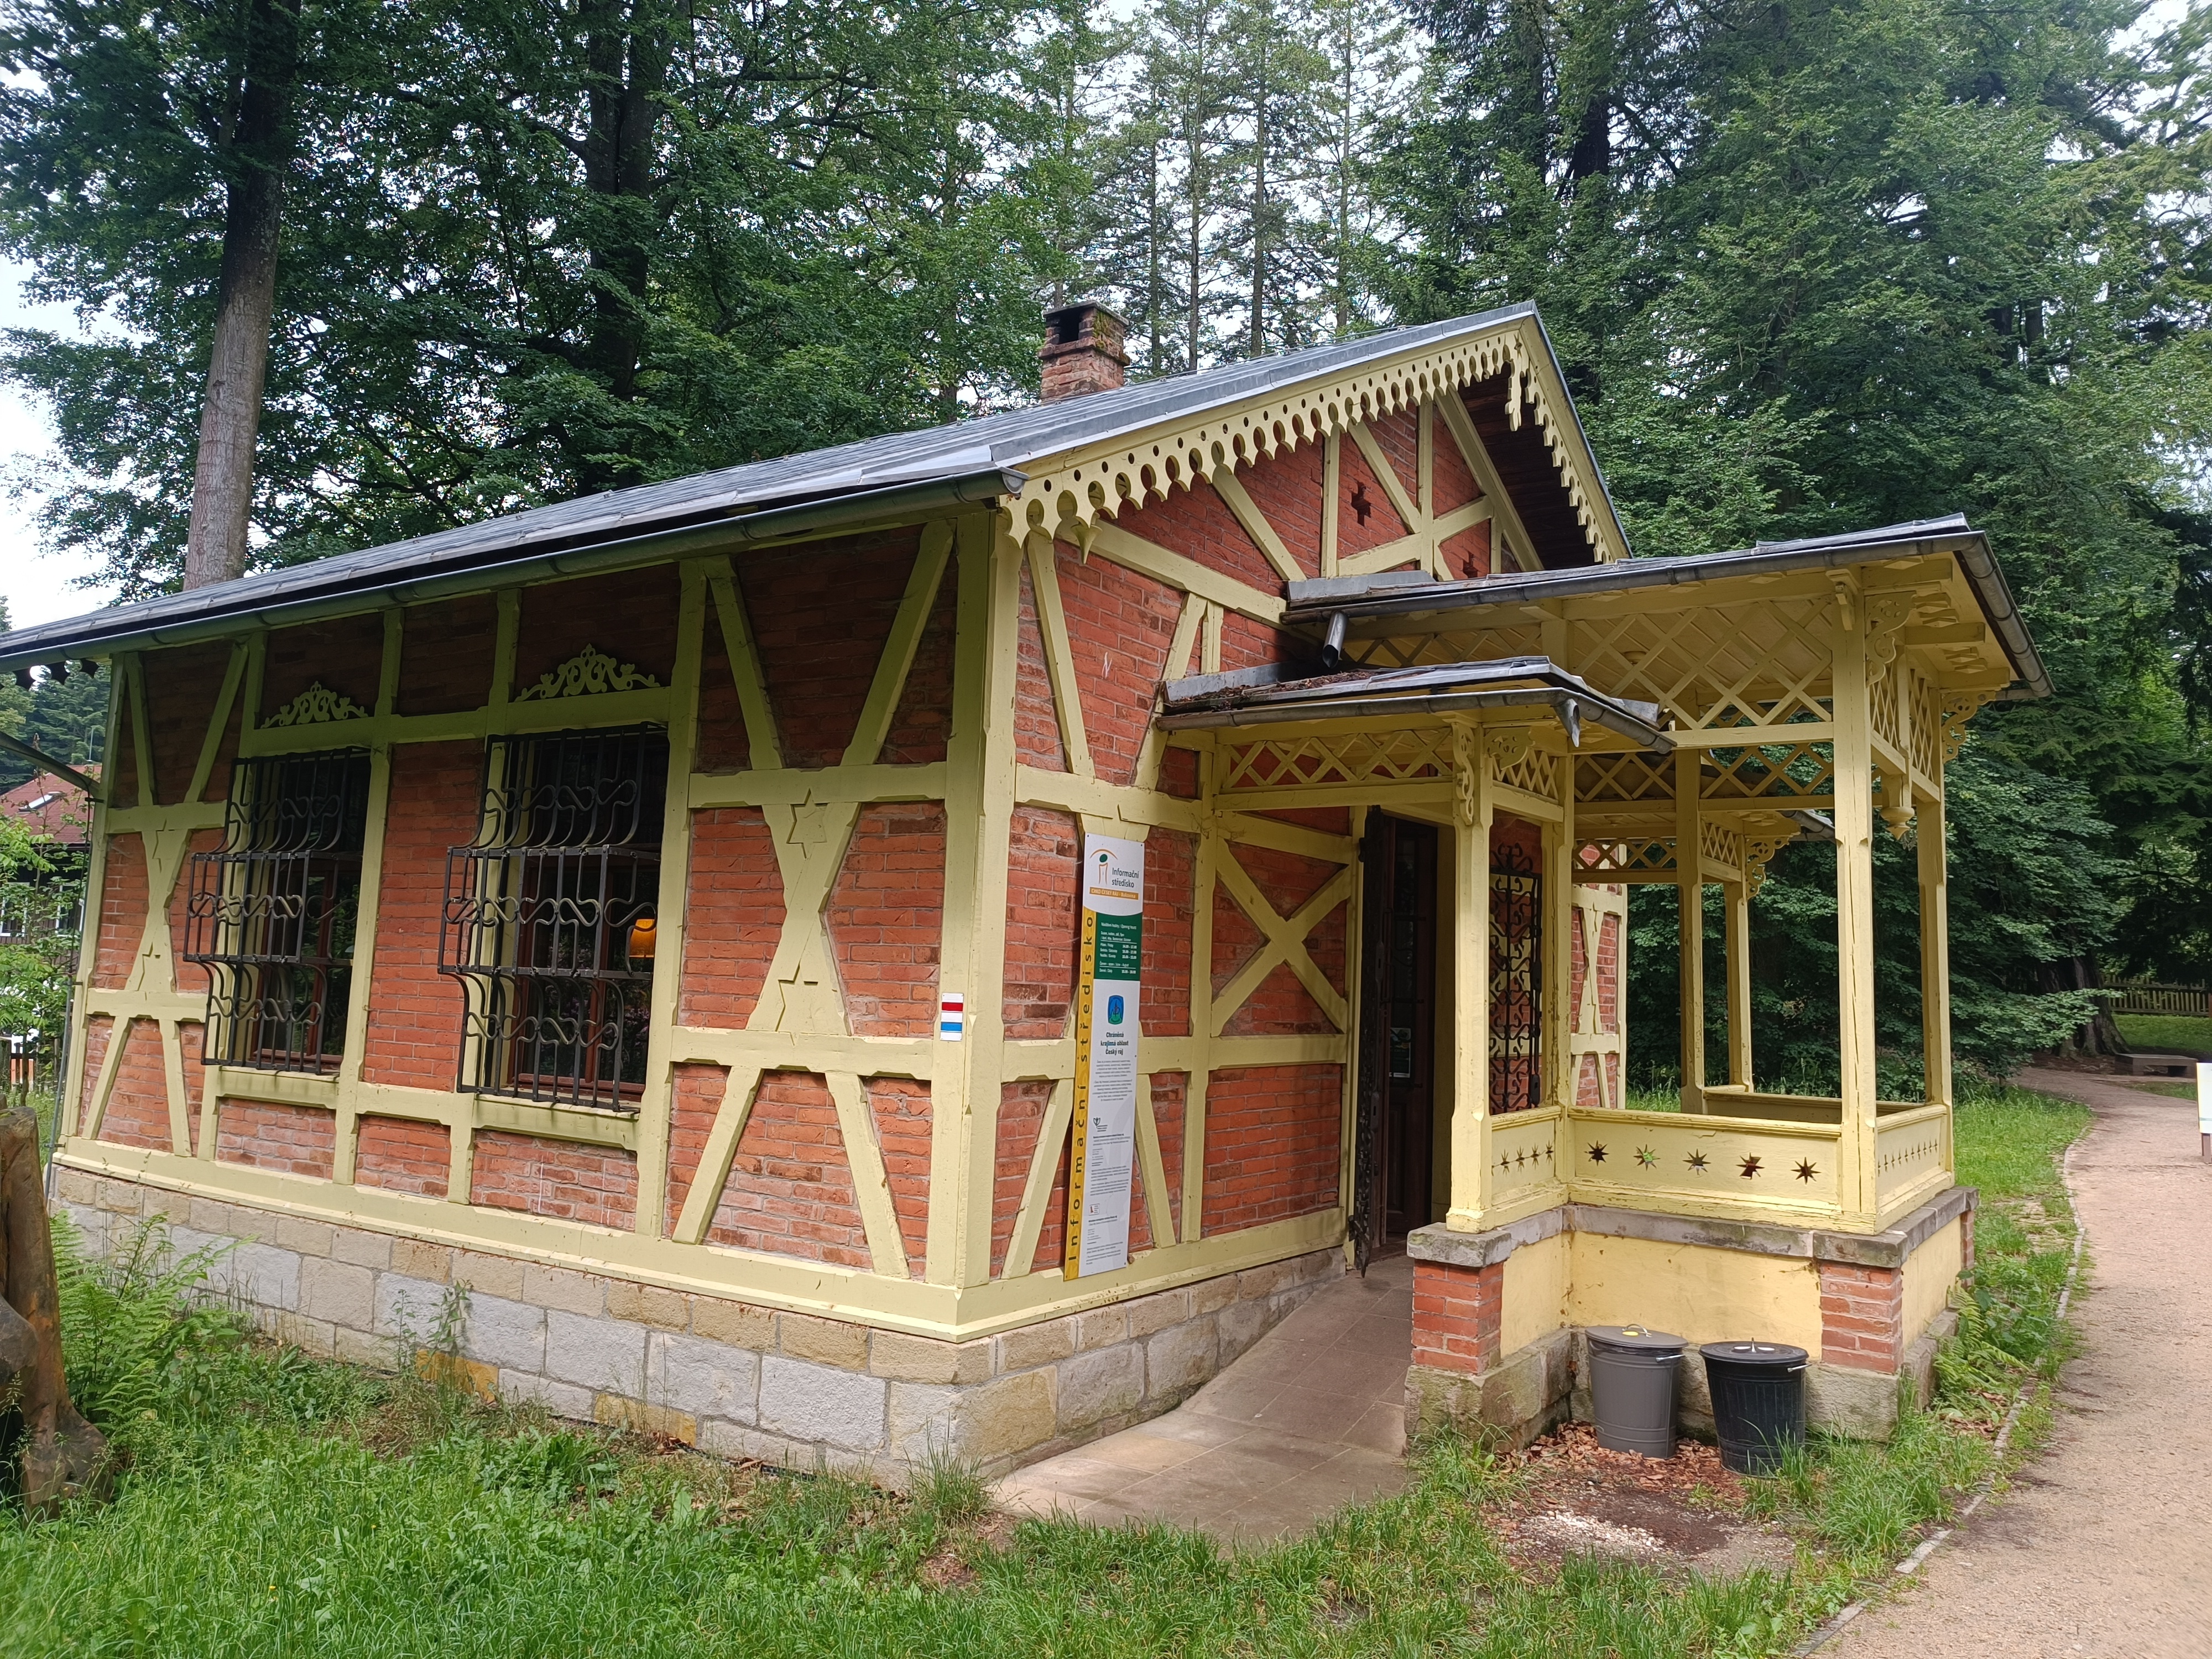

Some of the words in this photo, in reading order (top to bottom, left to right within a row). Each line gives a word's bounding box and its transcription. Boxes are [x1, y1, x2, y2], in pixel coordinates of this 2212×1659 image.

[1112, 867, 1139, 879] Informační
[1112, 878, 1134, 888] středisko
[1068, 1085, 1086, 1261] Informační
[1080, 916, 1093, 1062] středisko
